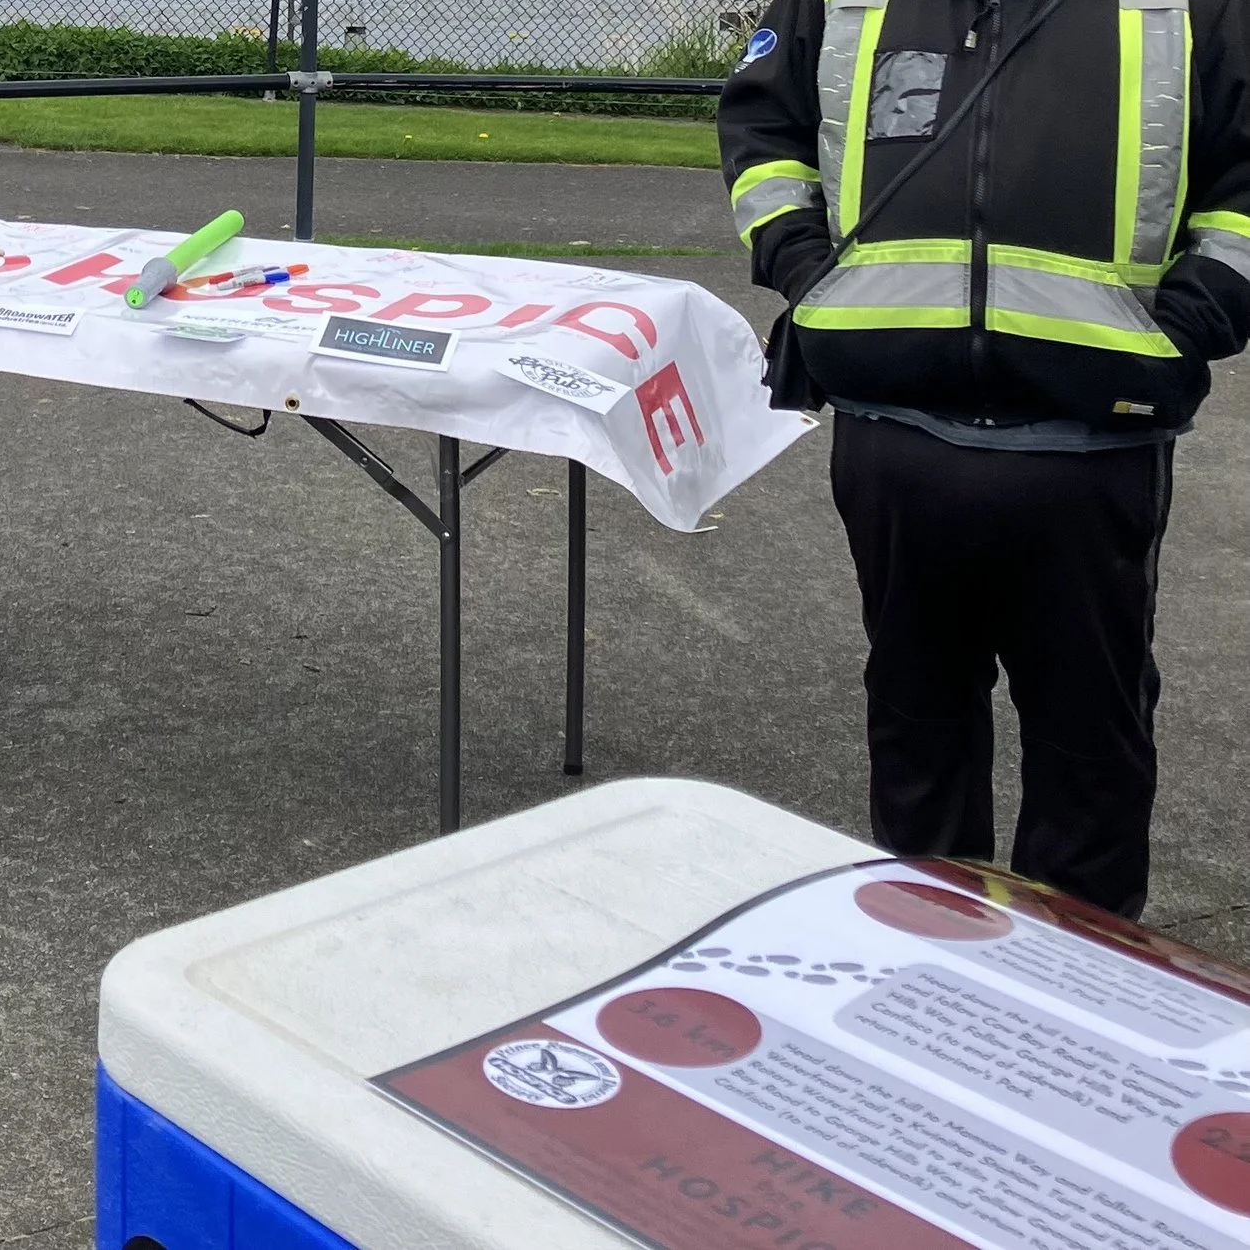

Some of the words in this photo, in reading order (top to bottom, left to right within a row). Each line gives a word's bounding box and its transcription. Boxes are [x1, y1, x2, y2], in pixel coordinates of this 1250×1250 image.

[334, 327, 435, 356] HIGHLINER
[540, 372, 581, 390] Pub
[853, 1014, 901, 1038] return
[901, 1034, 921, 1047] to
[921, 1043, 994, 1082] Mariner's
[900, 982, 935, 999] and
[932, 994, 979, 1018] follow
[980, 1015, 1016, 1035] Cow
[1016, 1031, 1050, 1051] Bay
[1051, 1047, 1101, 1071] Road
[1097, 1068, 1117, 1081] to
[1119, 1077, 1184, 1110] George
[916, 972, 963, 994] Head
[960, 992, 1002, 1013] down
[1004, 1010, 1030, 1026] the
[1032, 1021, 1063, 1038] hill
[1059, 1034, 1078, 1047] to
[766, 1050, 850, 1095] Waterfront
[848, 1090, 891, 1113] Trail
[886, 1111, 906, 1124] to
[780, 1041, 828, 1066] Head
[823, 1064, 865, 1086] down
[865, 1083, 893, 1100] the
[893, 1095, 925, 1112] hill
[921, 1110, 941, 1124] to
[1014, 1151, 1052, 1177] Way
[1053, 1174, 1095, 1196] and
[935, 1031, 961, 1047] (to
[961, 1044, 998, 1062] end
[994, 1059, 1019, 1071] of
[1094, 1104, 1135, 1125] and
[961, 1024, 1013, 1051] Follow
[1014, 1048, 1075, 1079] George
[1119, 1091, 1160, 1118] Way
[1161, 1113, 1184, 1129] to
[729, 1067, 760, 1087] Bay
[761, 1083, 808, 1108] Road
[804, 1105, 823, 1118] to
[823, 1114, 883, 1148] George
[966, 1186, 1026, 1219] Follow
[748, 1059, 801, 1088] Rotary
[801, 1083, 887, 1130] Waterfront
[887, 1127, 930, 1151] Trail
[925, 1148, 947, 1162] to
[1069, 1220, 1111, 1243] and
[776, 1110, 804, 1126] (to
[803, 1124, 840, 1143] end
[835, 1140, 860, 1151] of
[934, 1190, 974, 1211] and
[970, 1208, 1027, 1240] return
